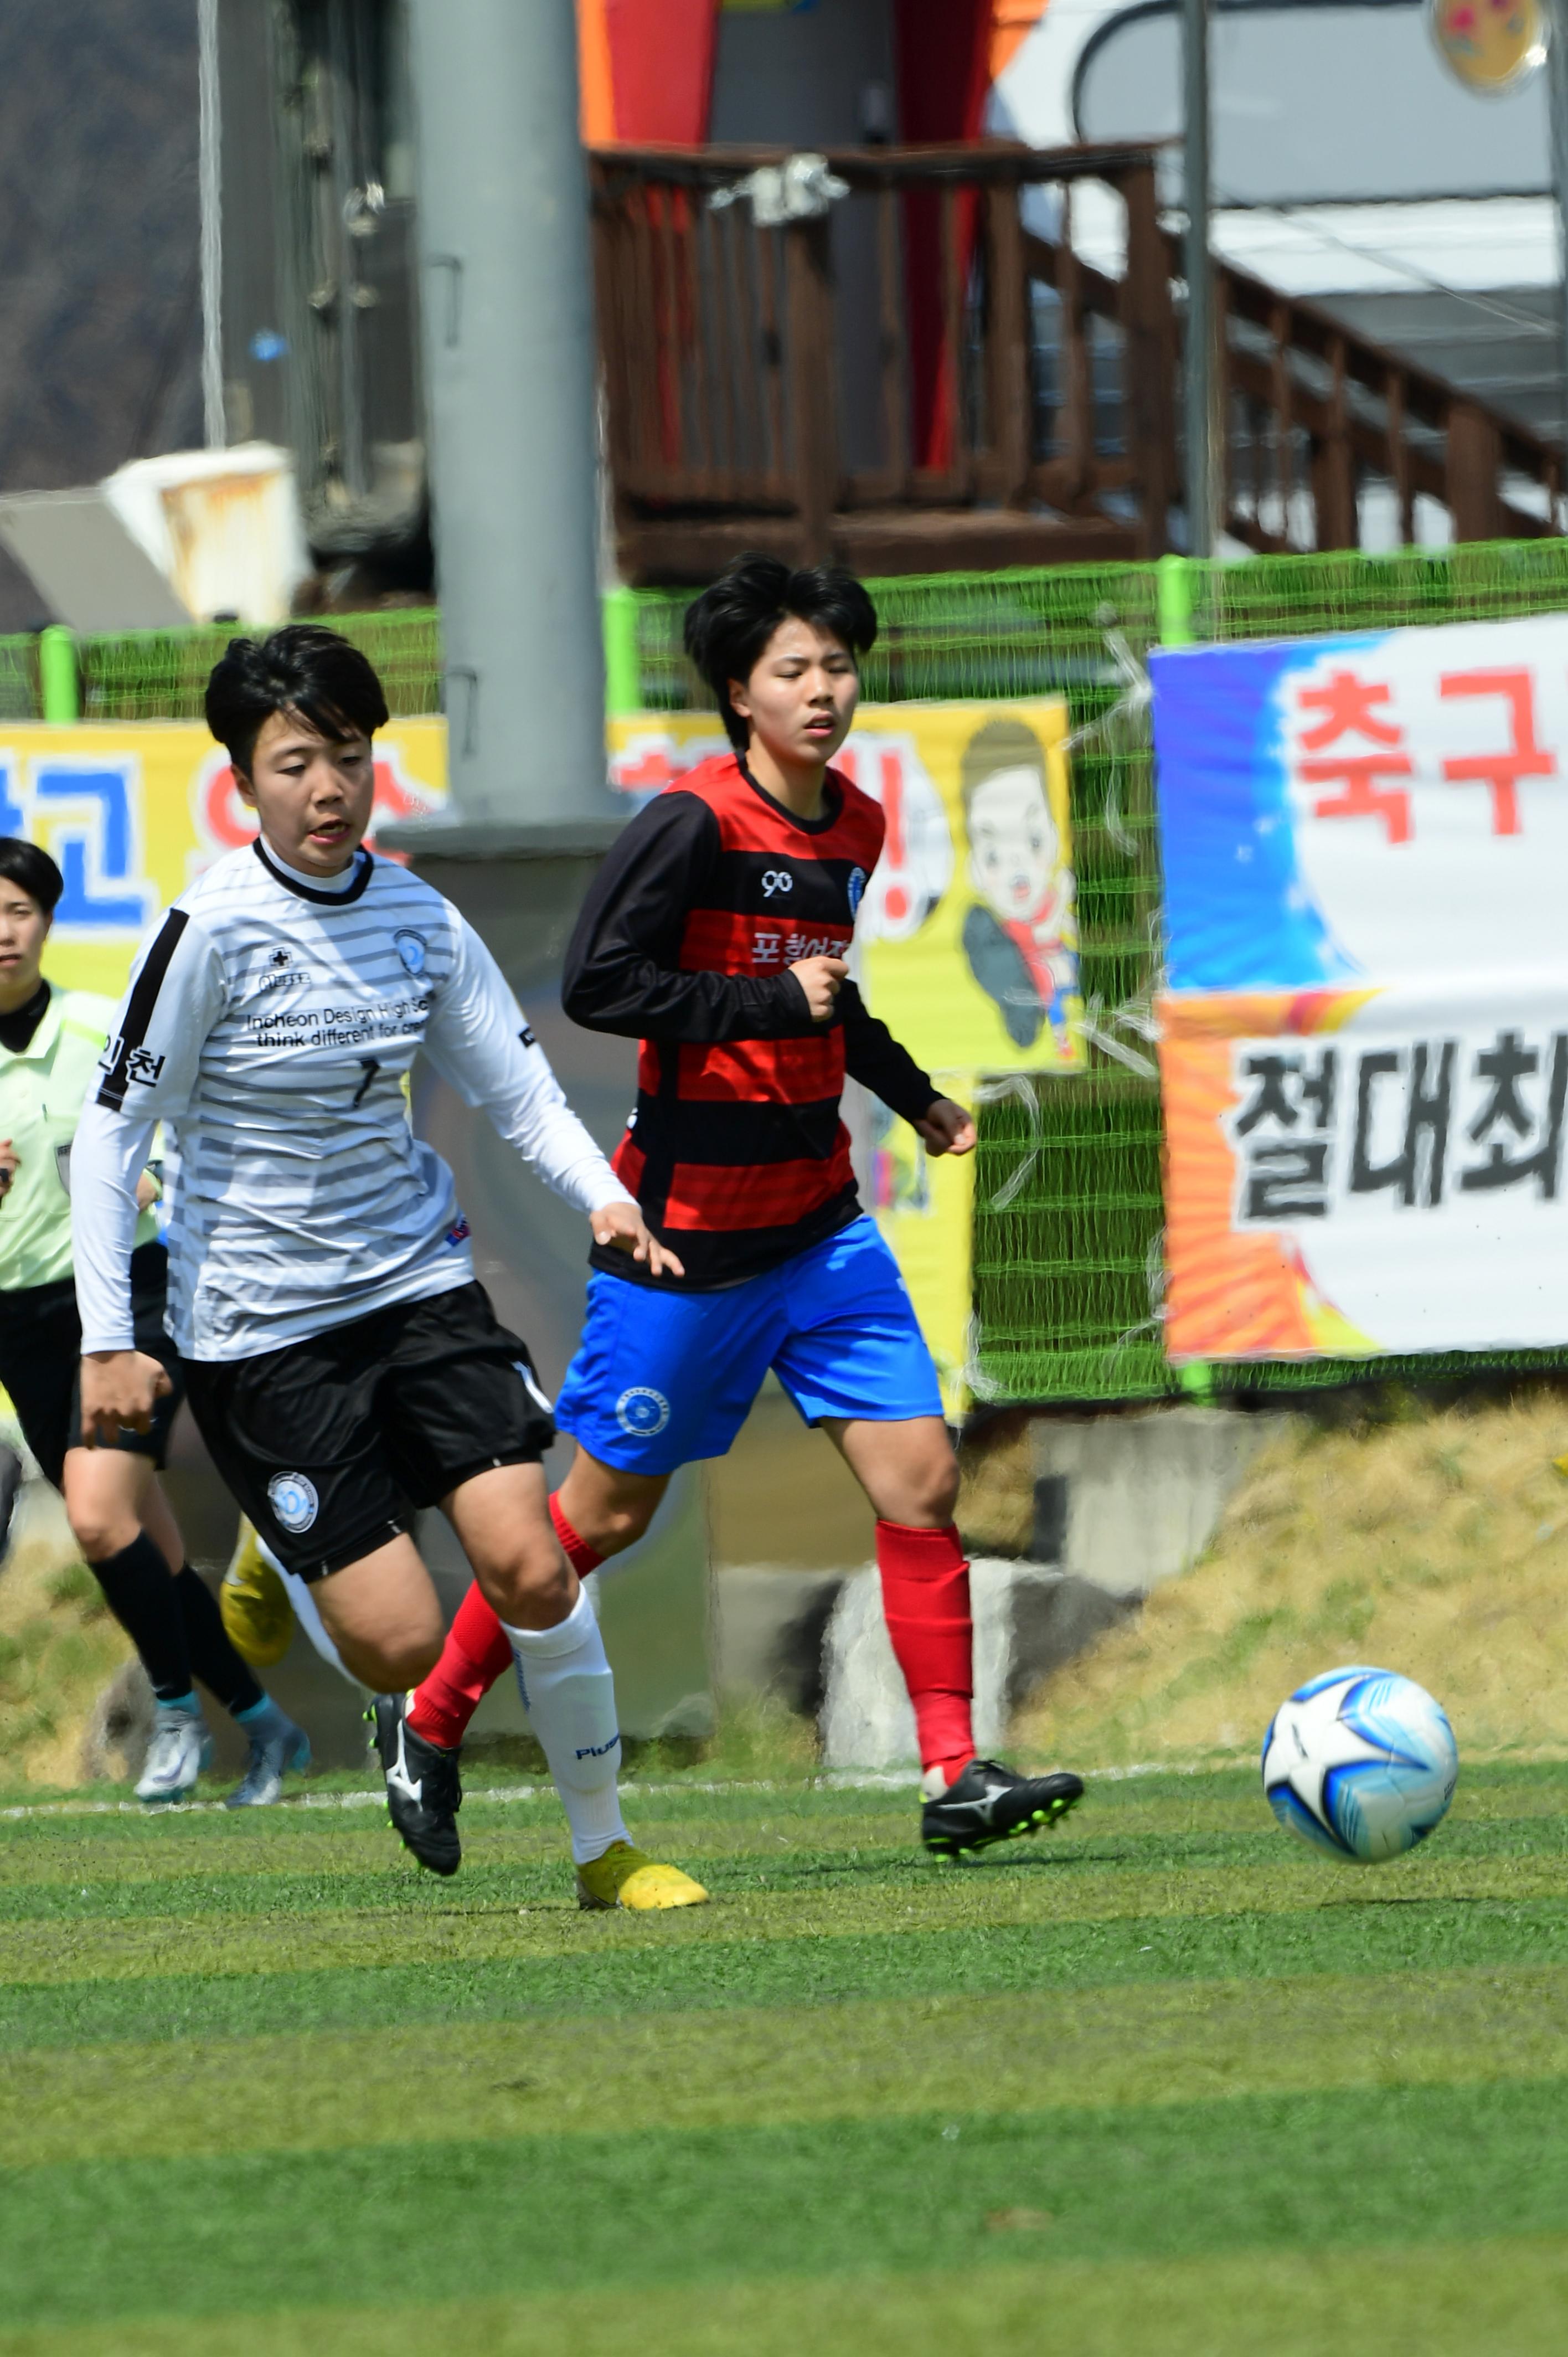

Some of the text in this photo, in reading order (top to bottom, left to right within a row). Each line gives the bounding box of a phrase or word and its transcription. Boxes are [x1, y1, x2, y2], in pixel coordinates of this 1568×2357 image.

[1298, 666, 1556, 845] 축구
[0, 768, 145, 925] 고
[761, 870, 793, 898] 90
[247, 1013, 319, 1030] Incheon
[323, 1005, 377, 1024] Design
[377, 1000, 411, 1020] High
[256, 1020, 425, 1047] think different for cre
[98, 1034, 166, 1088] 인천
[353, 1057, 381, 1108] 7
[576, 1733, 620, 1760] Plus
